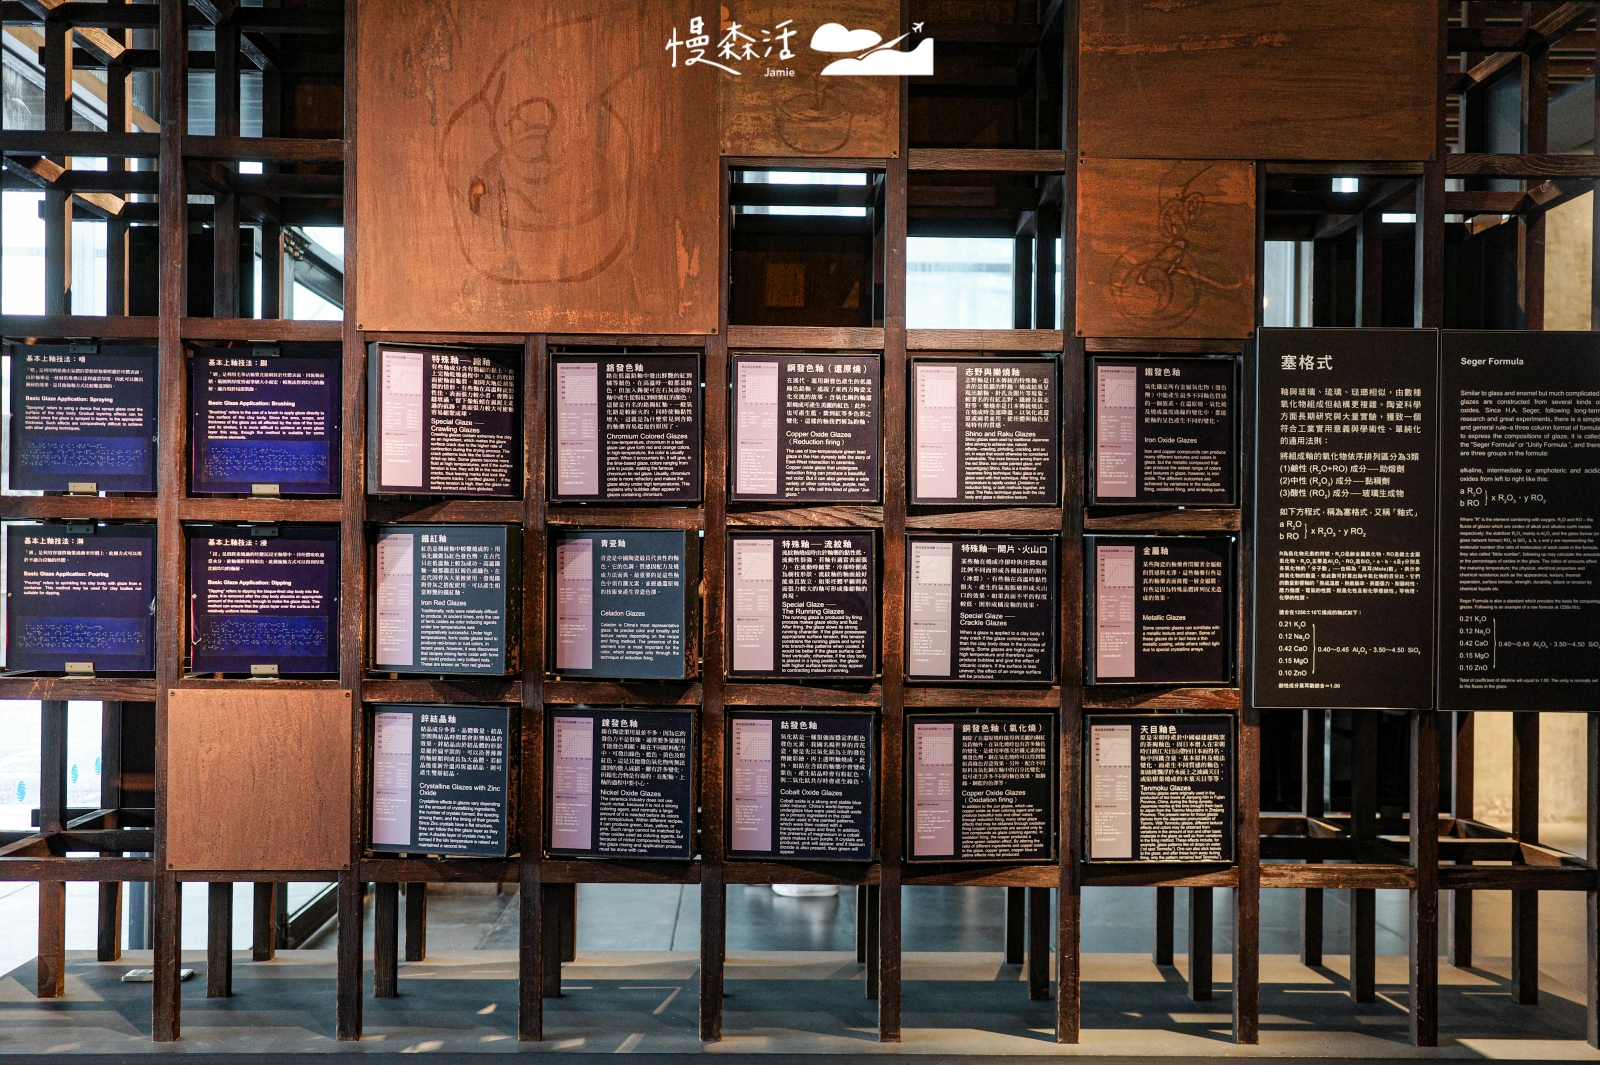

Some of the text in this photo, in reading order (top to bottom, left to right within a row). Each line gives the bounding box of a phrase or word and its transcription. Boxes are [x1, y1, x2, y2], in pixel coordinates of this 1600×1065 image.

[1281, 354, 1333, 370] 塞格式
[1461, 357, 1524, 367] Seger Formula
[786, 430, 809, 438] Copper
[1286, 532, 1299, 540] RO
[601, 539, 626, 548] 青瓷釉
[1143, 546, 1168, 555] 金屬釉
[795, 608, 821, 616] Running
[421, 714, 456, 723] 鋅結晶釉
[1140, 725, 1177, 734] 天目釉色
[419, 782, 450, 790] Crystalline
